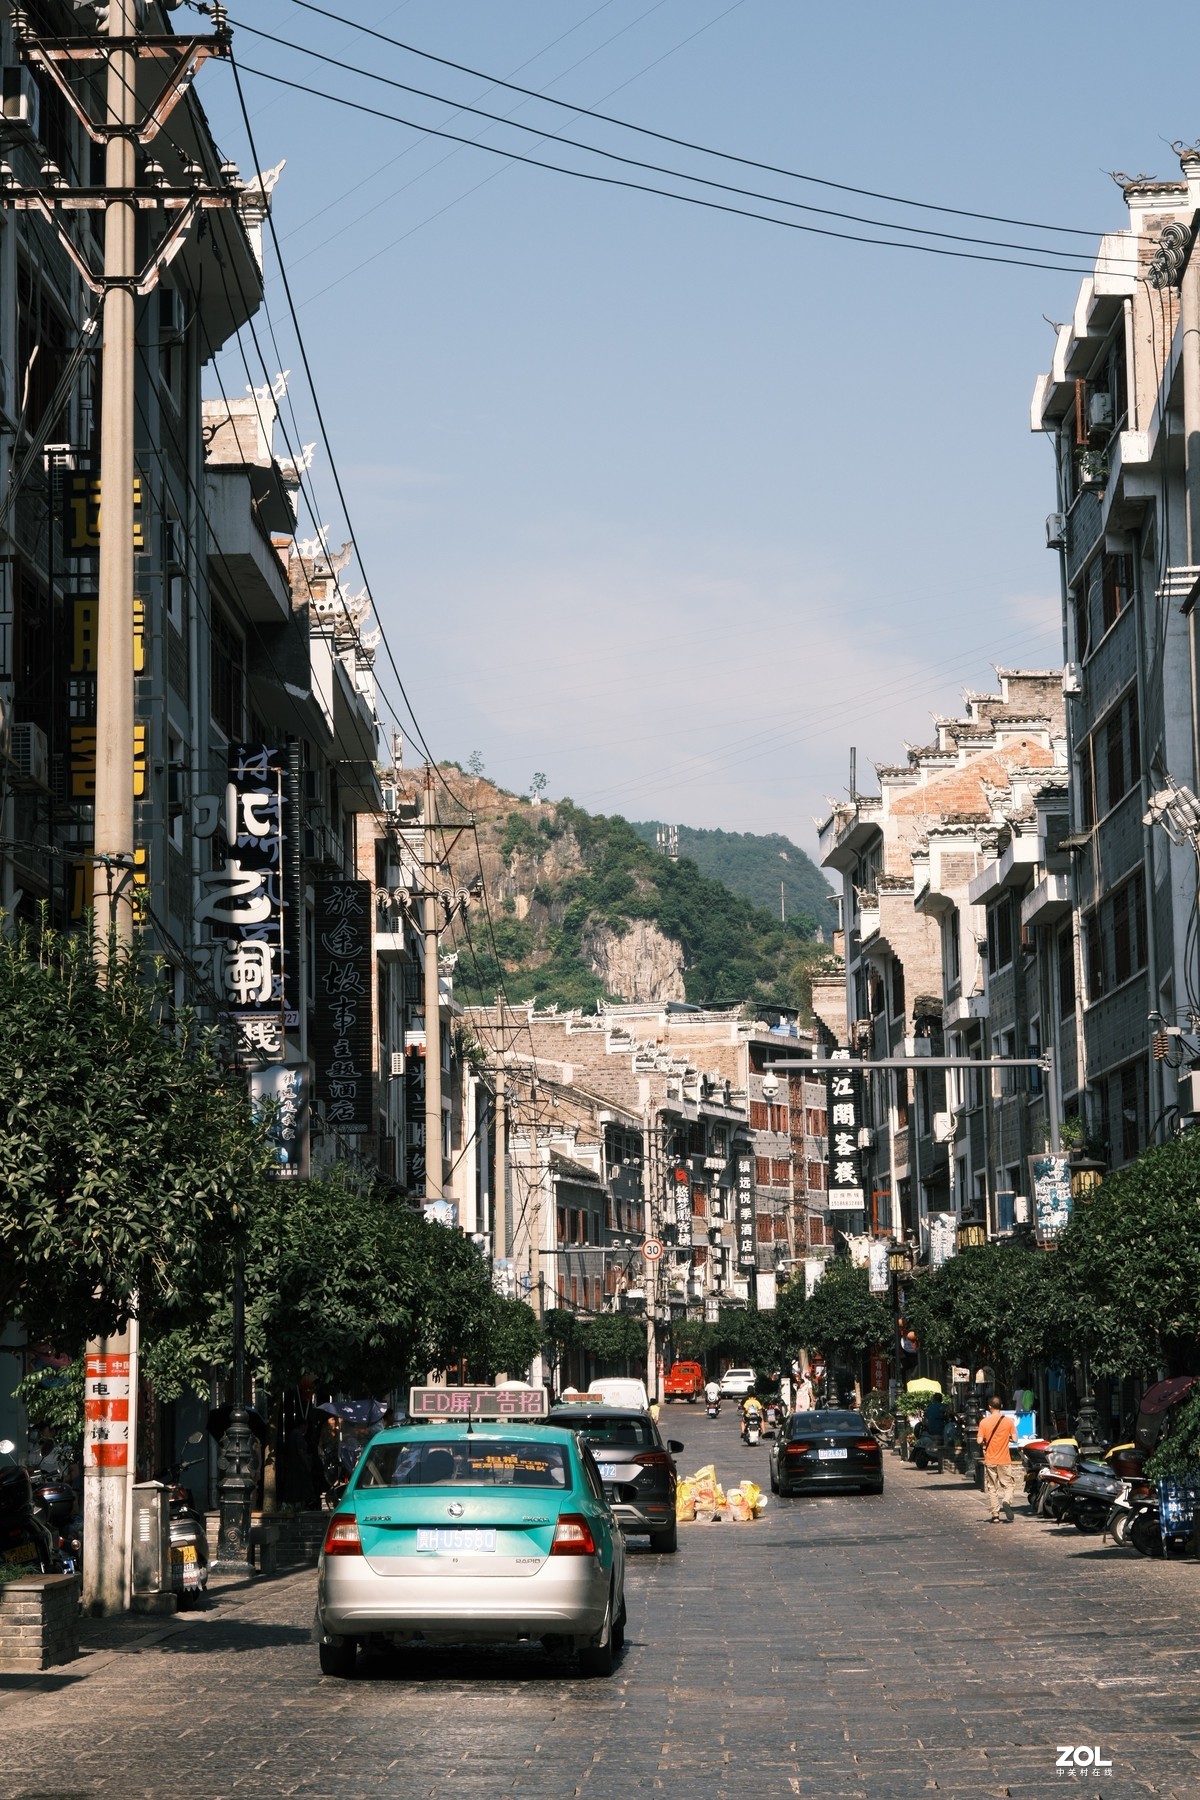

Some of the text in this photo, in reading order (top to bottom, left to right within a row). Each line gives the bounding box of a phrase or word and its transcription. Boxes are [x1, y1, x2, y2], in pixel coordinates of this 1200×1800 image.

[321, 886, 366, 1122] 旅途故事主题酒店
[646, 1245, 659, 1255] 30
[739, 1160, 753, 1252] 镇远悦季酒店
